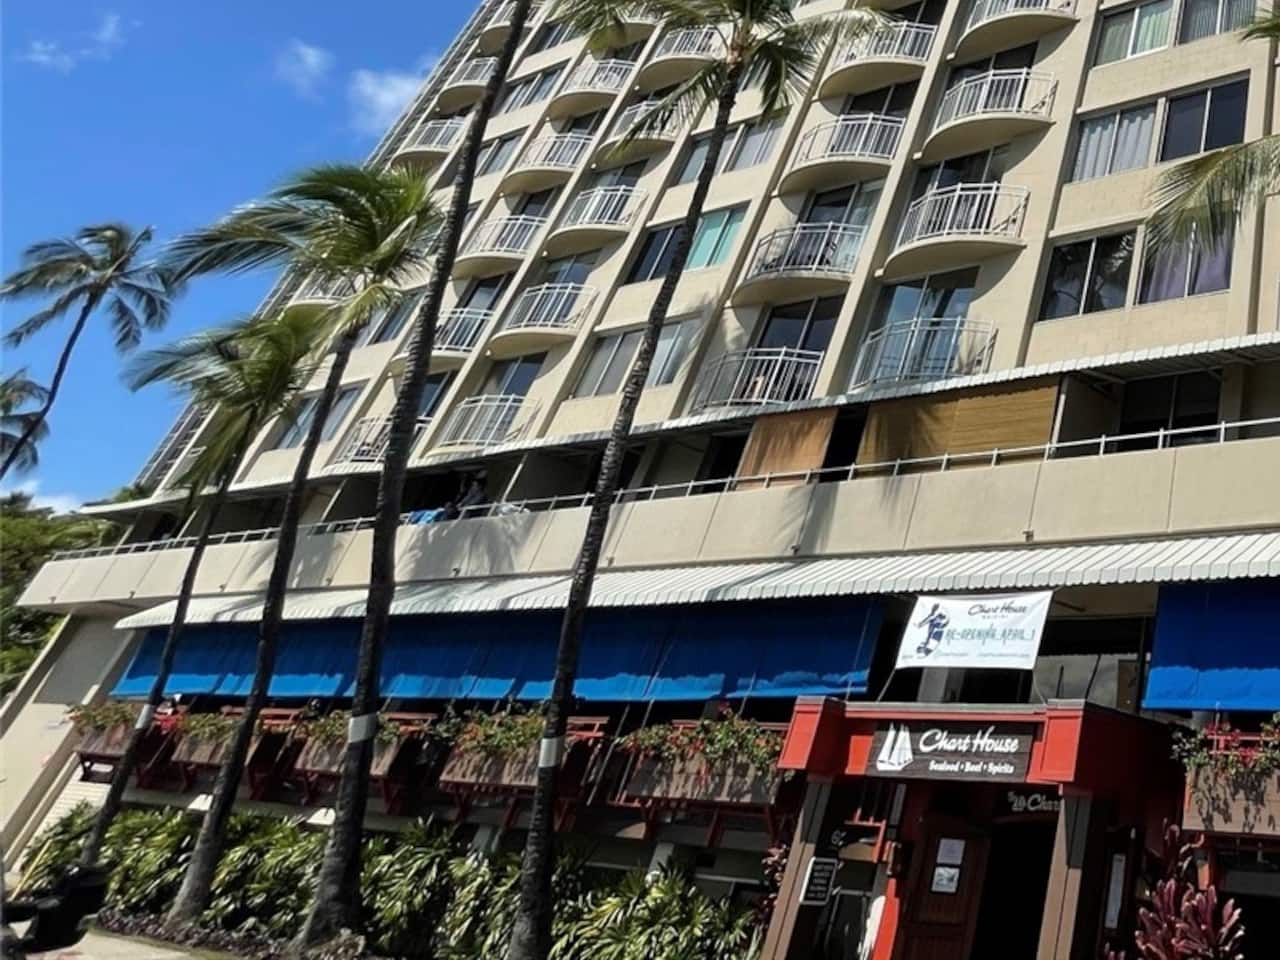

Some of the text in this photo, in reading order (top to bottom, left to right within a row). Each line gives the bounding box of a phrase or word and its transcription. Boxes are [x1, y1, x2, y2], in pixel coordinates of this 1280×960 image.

[919, 725, 1018, 752] Chart House
[929, 760, 1014, 775] Seafood Beef Spirits
